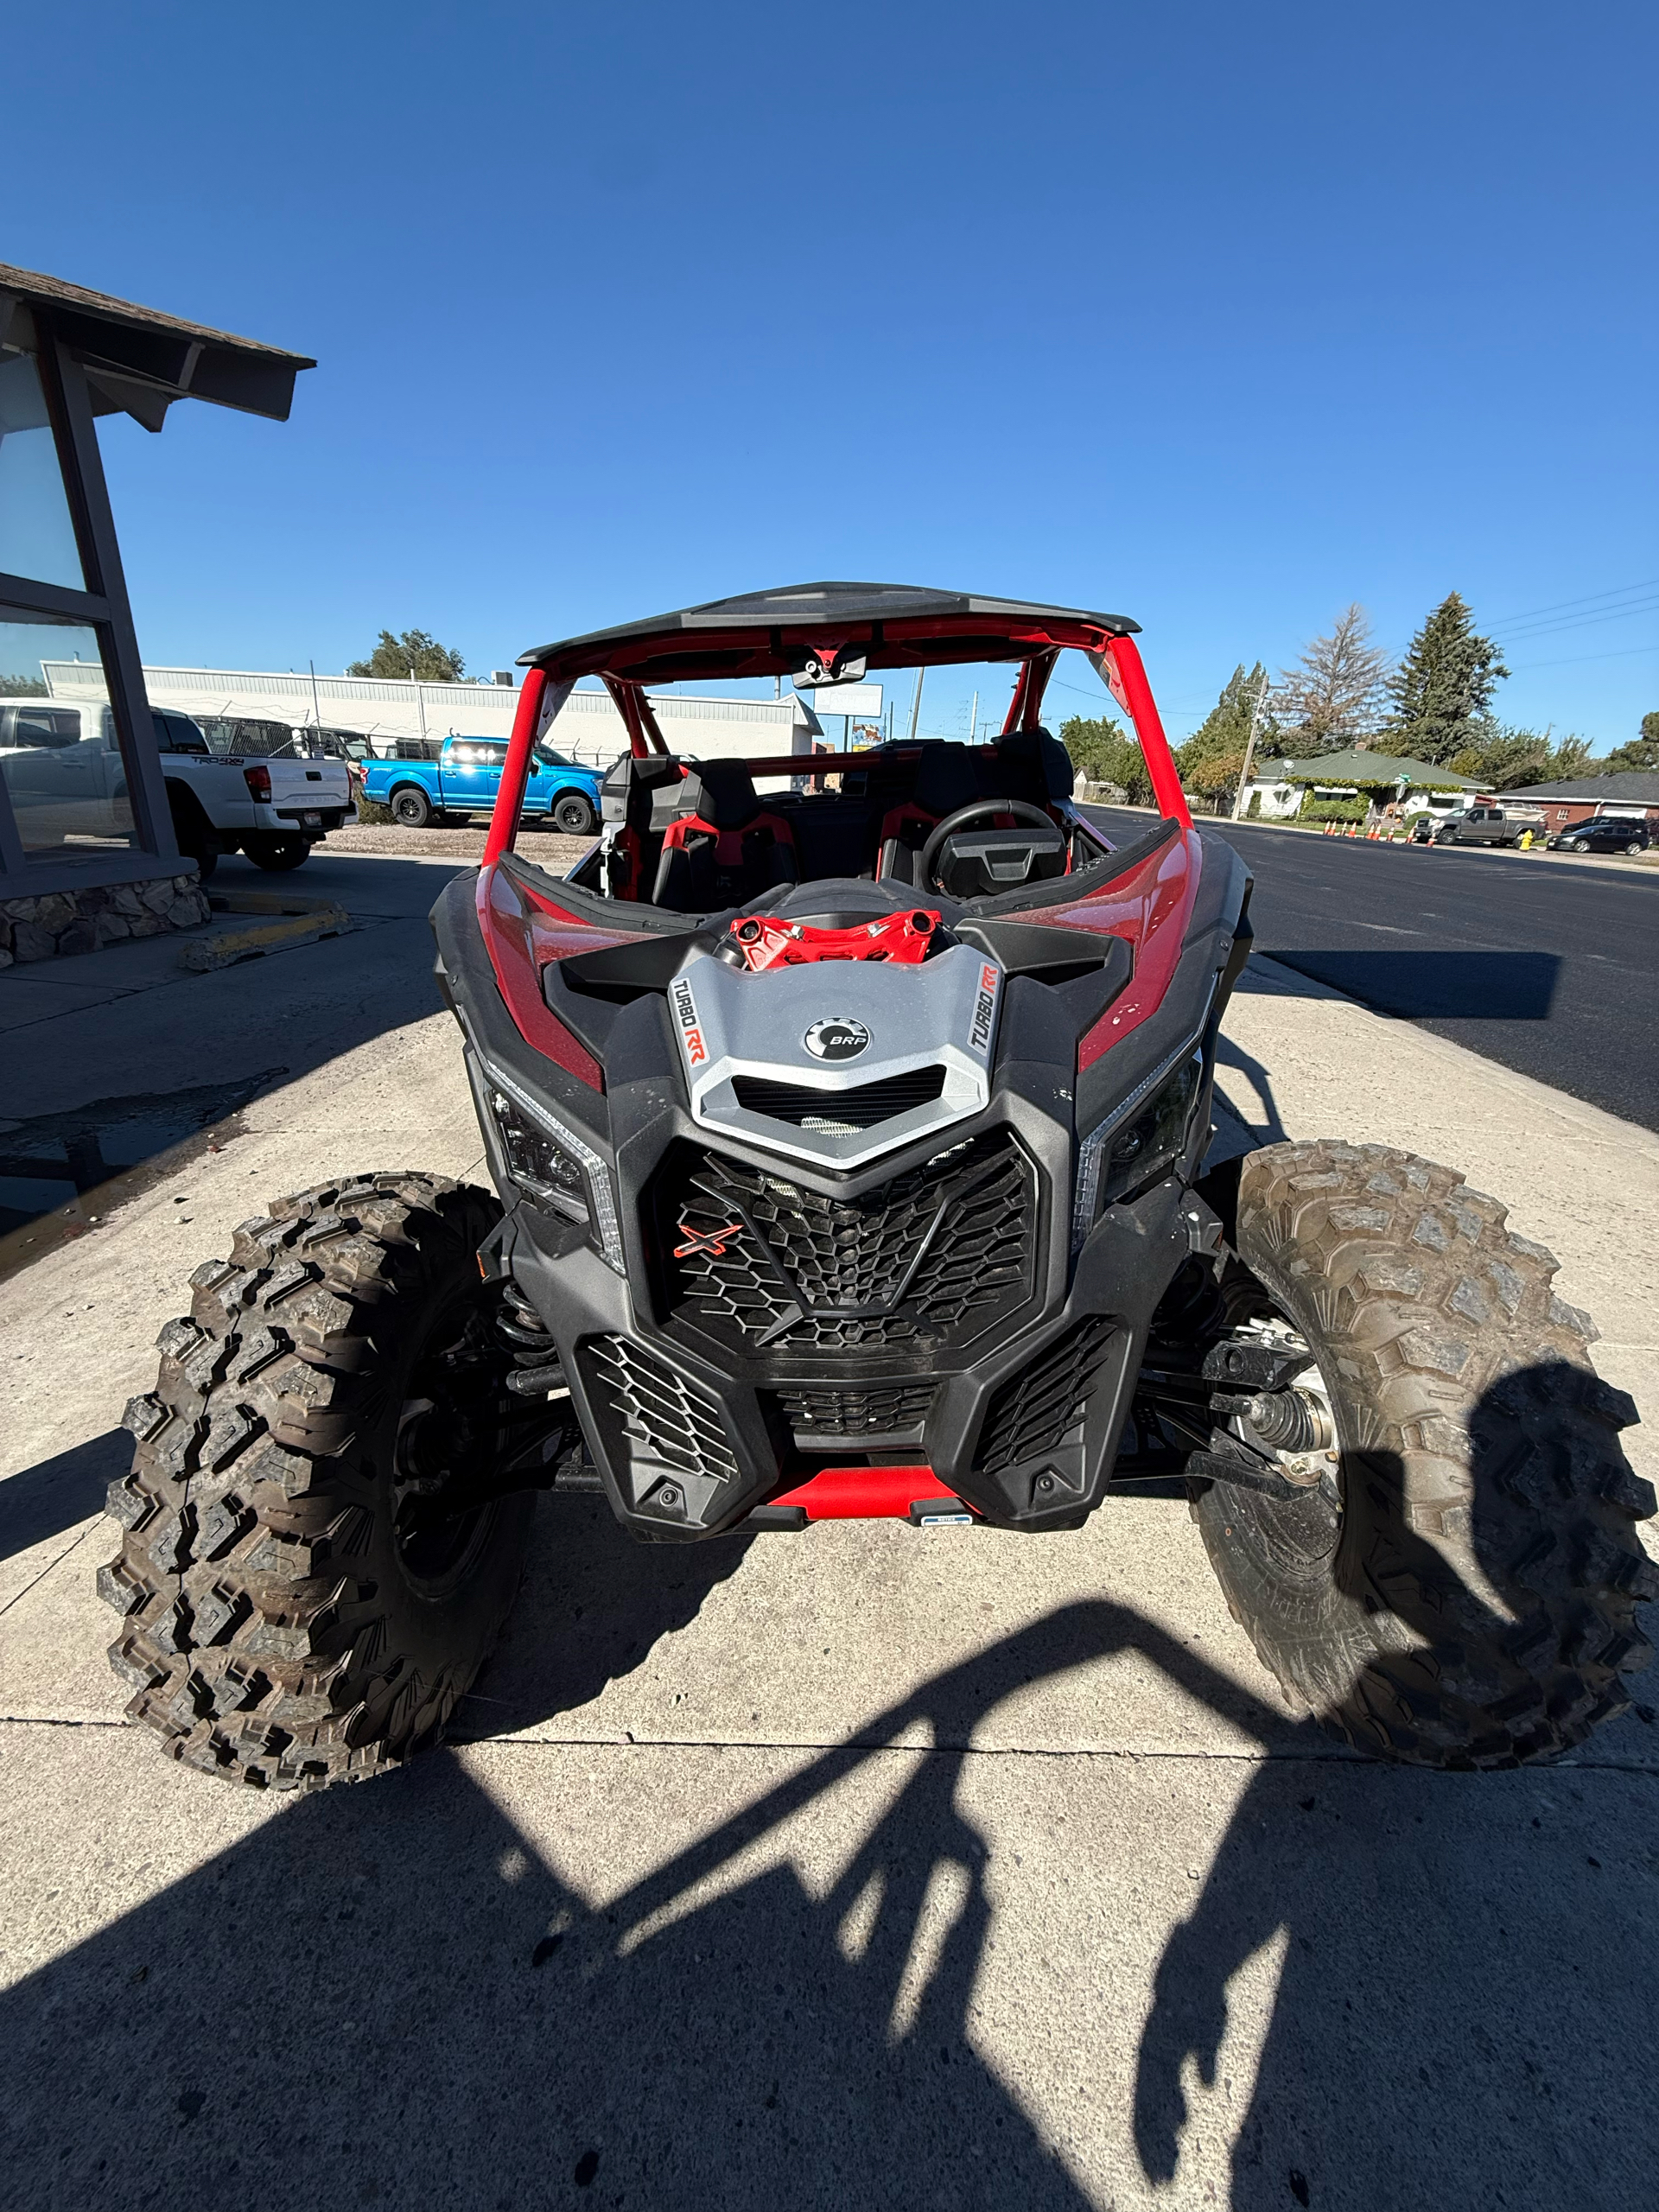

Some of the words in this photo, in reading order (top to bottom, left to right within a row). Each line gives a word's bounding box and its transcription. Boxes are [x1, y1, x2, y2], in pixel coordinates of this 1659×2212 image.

[982, 965, 998, 994] RR
[674, 981, 696, 1027] TURBO
[971, 991, 994, 1049] TURBO
[684, 1028, 705, 1065] RR
[830, 1036, 867, 1045] BRP
